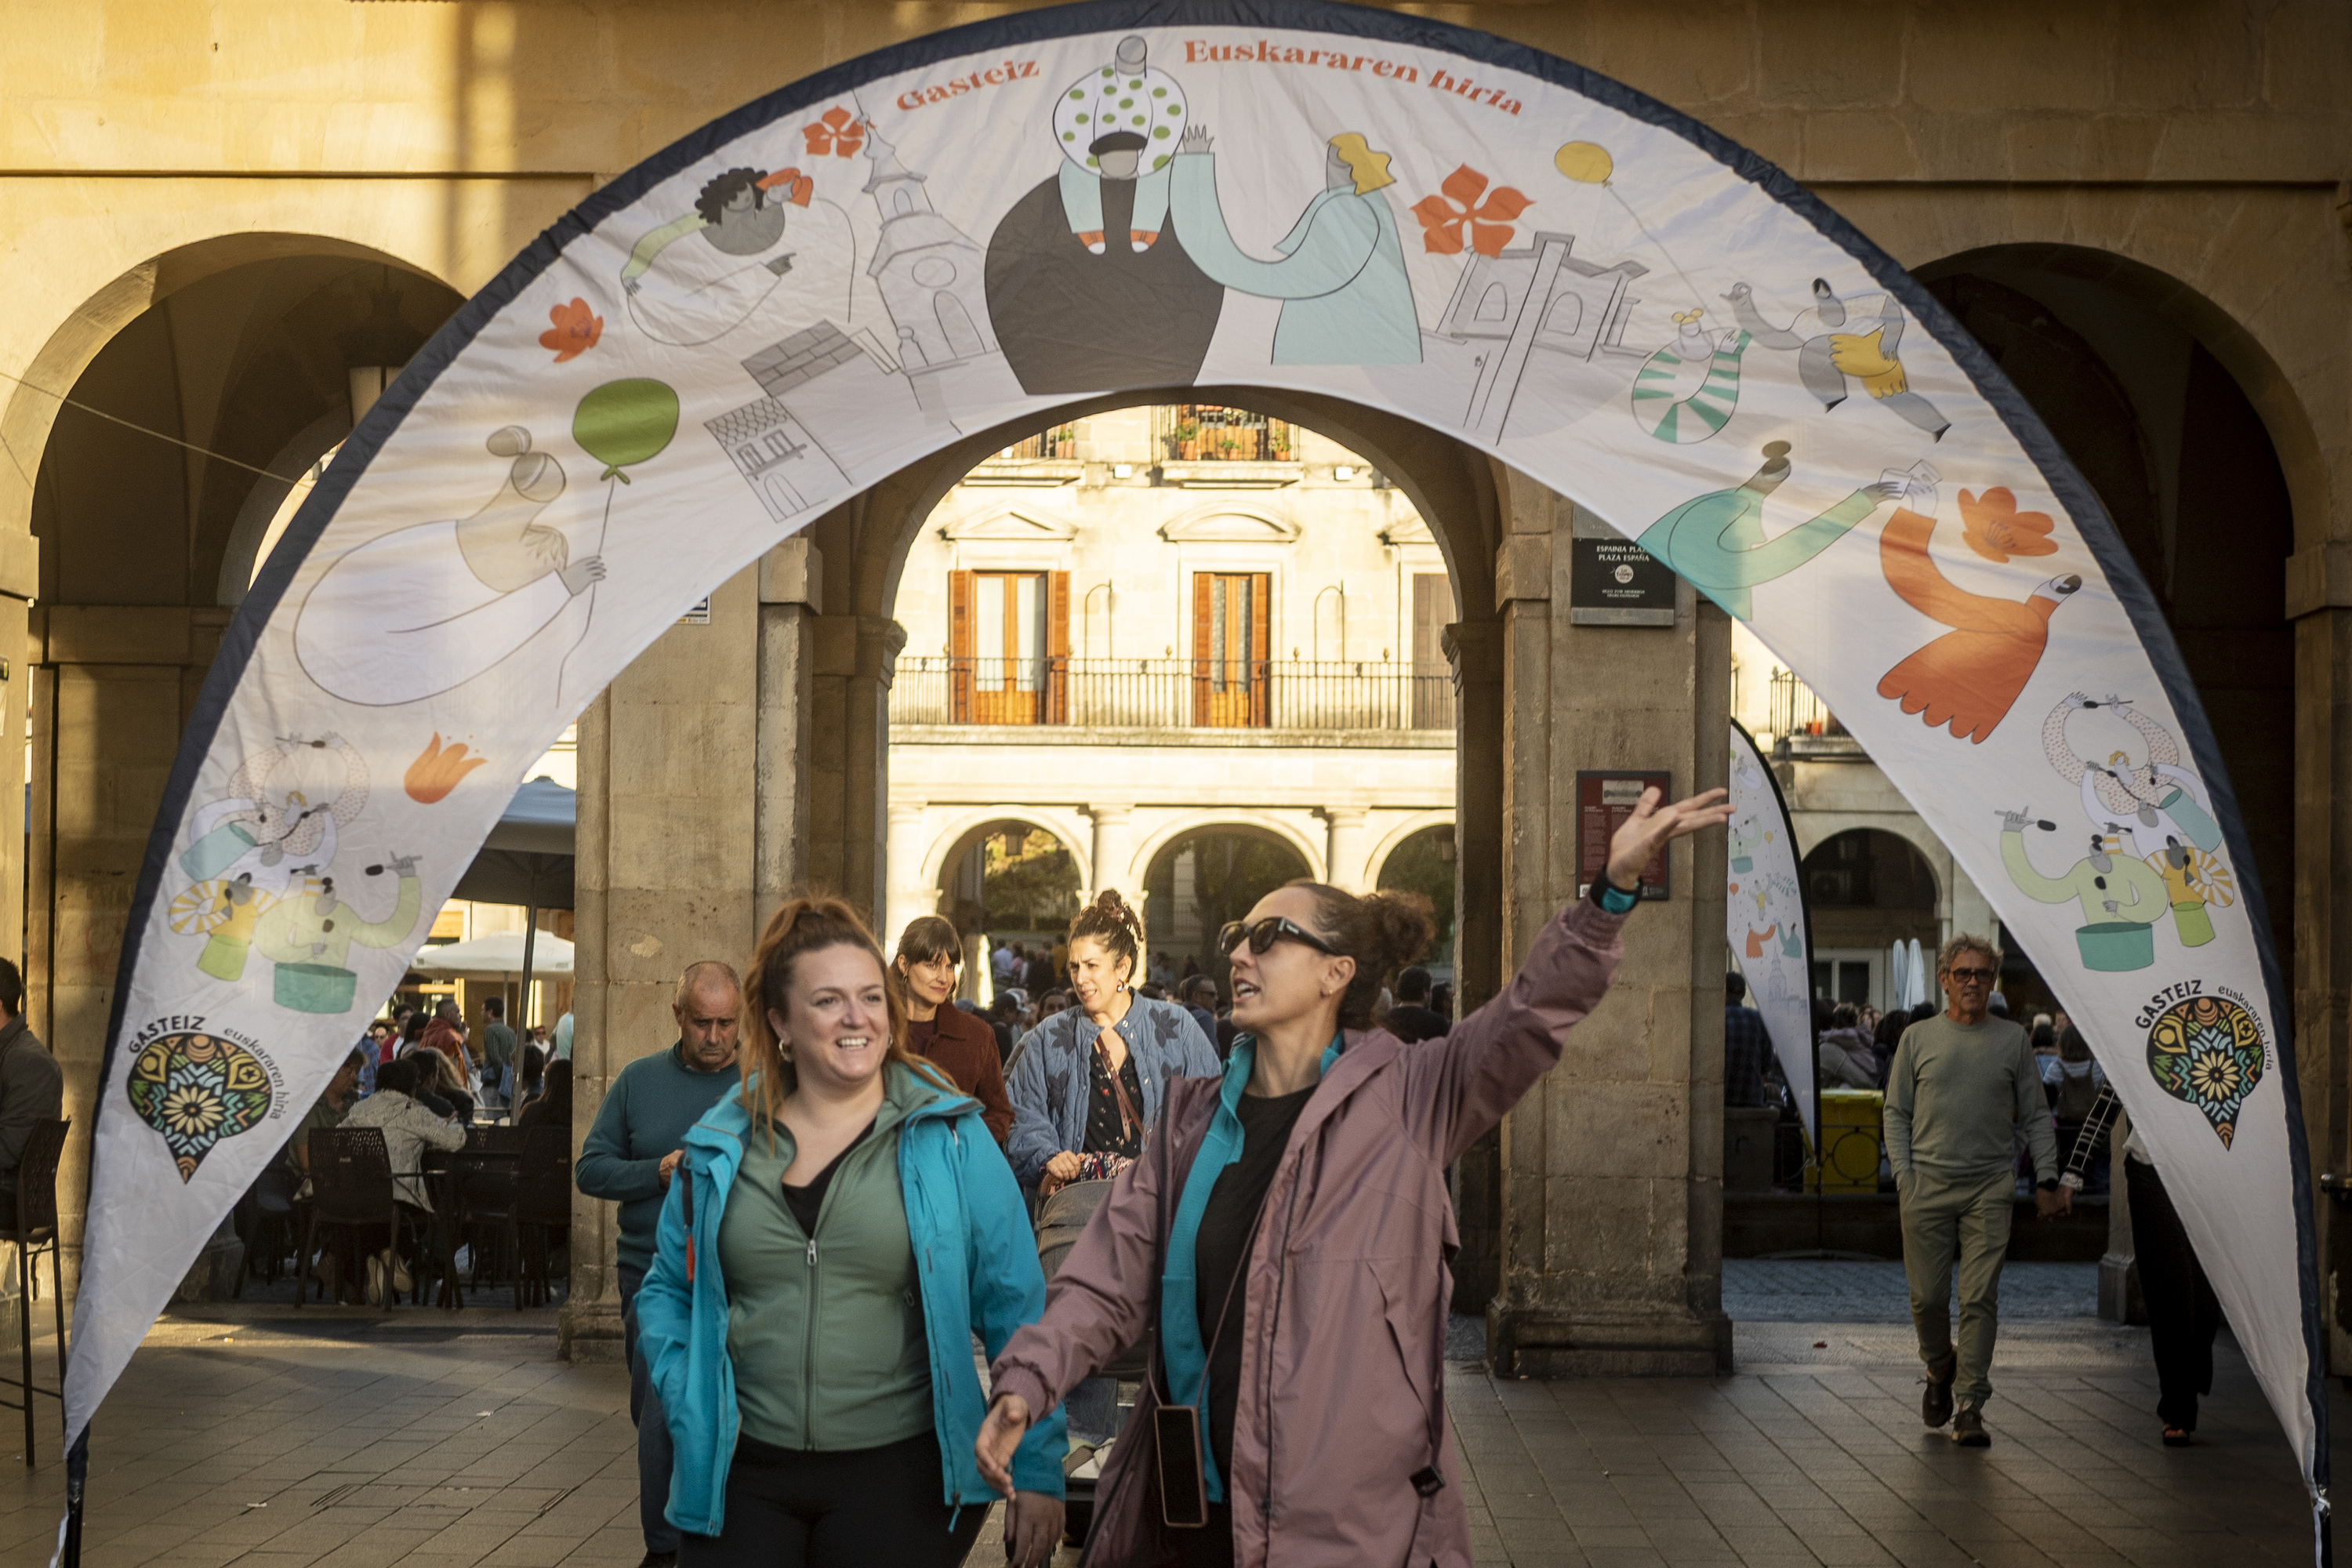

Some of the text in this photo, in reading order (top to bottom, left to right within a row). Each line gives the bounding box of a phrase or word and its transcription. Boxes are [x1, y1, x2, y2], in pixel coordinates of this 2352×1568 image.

[897, 39, 1523, 117] Gasteiz Euskararen hiria
[1623, 553, 1650, 562] ESPAÑA
[2135, 979, 2202, 1029] GASTEIZ
[2218, 985, 2266, 1038] euskararen
[129, 1015, 290, 1120] GASTEIZ euskararen hiria
